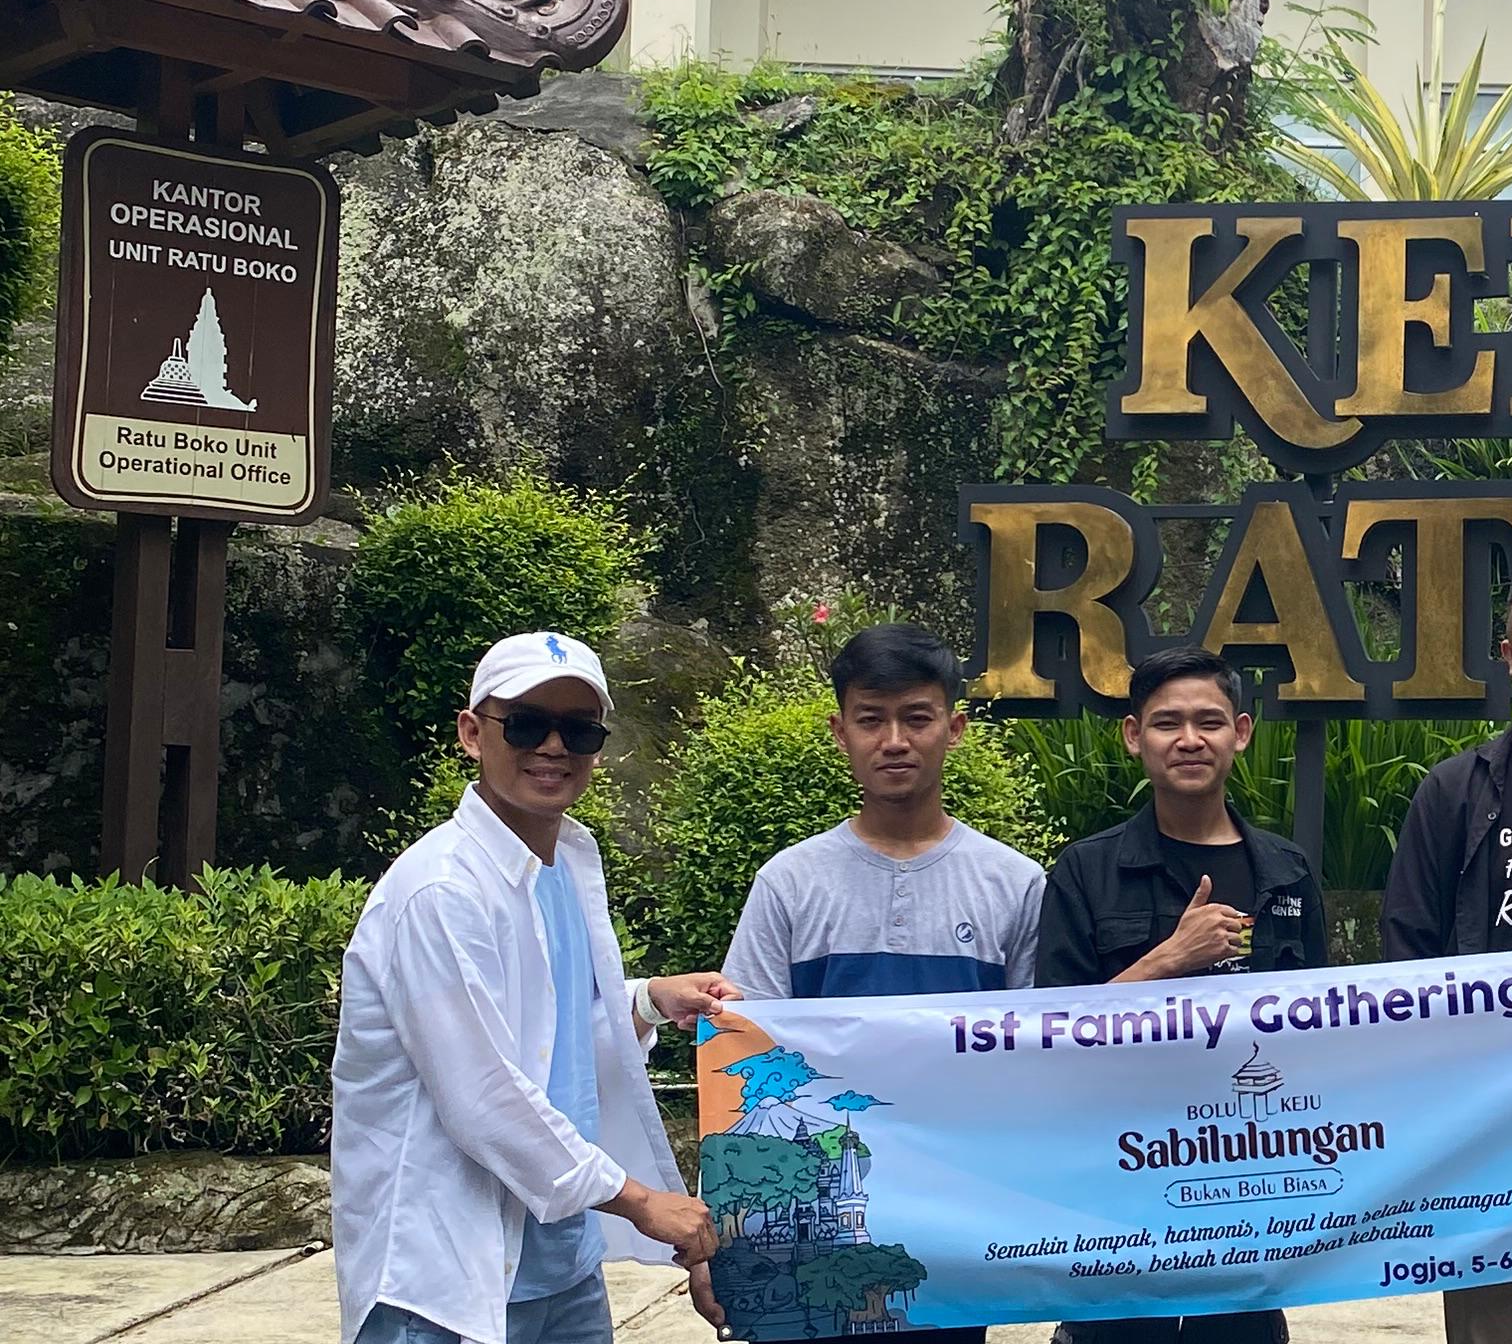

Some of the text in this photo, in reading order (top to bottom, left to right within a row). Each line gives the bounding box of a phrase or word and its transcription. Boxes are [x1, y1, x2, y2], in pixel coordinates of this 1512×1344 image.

[153, 179, 261, 217] KANTOR
[110, 202, 299, 251] OPERASIONAL
[109, 239, 298, 284] UNIT RATU BOKO
[117, 426, 278, 459] Ratu Boko Unit
[99, 450, 292, 486] Operational Office
[950, 1011, 1021, 1054] 1st
[1041, 996, 1231, 1050] Family
[1187, 1094, 1322, 1121] BOLU KEJU
[1118, 1120, 1385, 1172] Sabilulungan
[984, 1236, 1068, 1261] Semakin
[1073, 1228, 1157, 1254] kompak,
[1164, 1219, 1259, 1245] harmonis,
[1266, 1212, 1316, 1238] loyal
[1320, 1211, 1358, 1231] dan
[1361, 1199, 1416, 1225] selalu
[1069, 1221, 1435, 1279] Sukses, berkah dan menebar kebaikan
[1379, 1256, 1464, 1287] Jogja,
